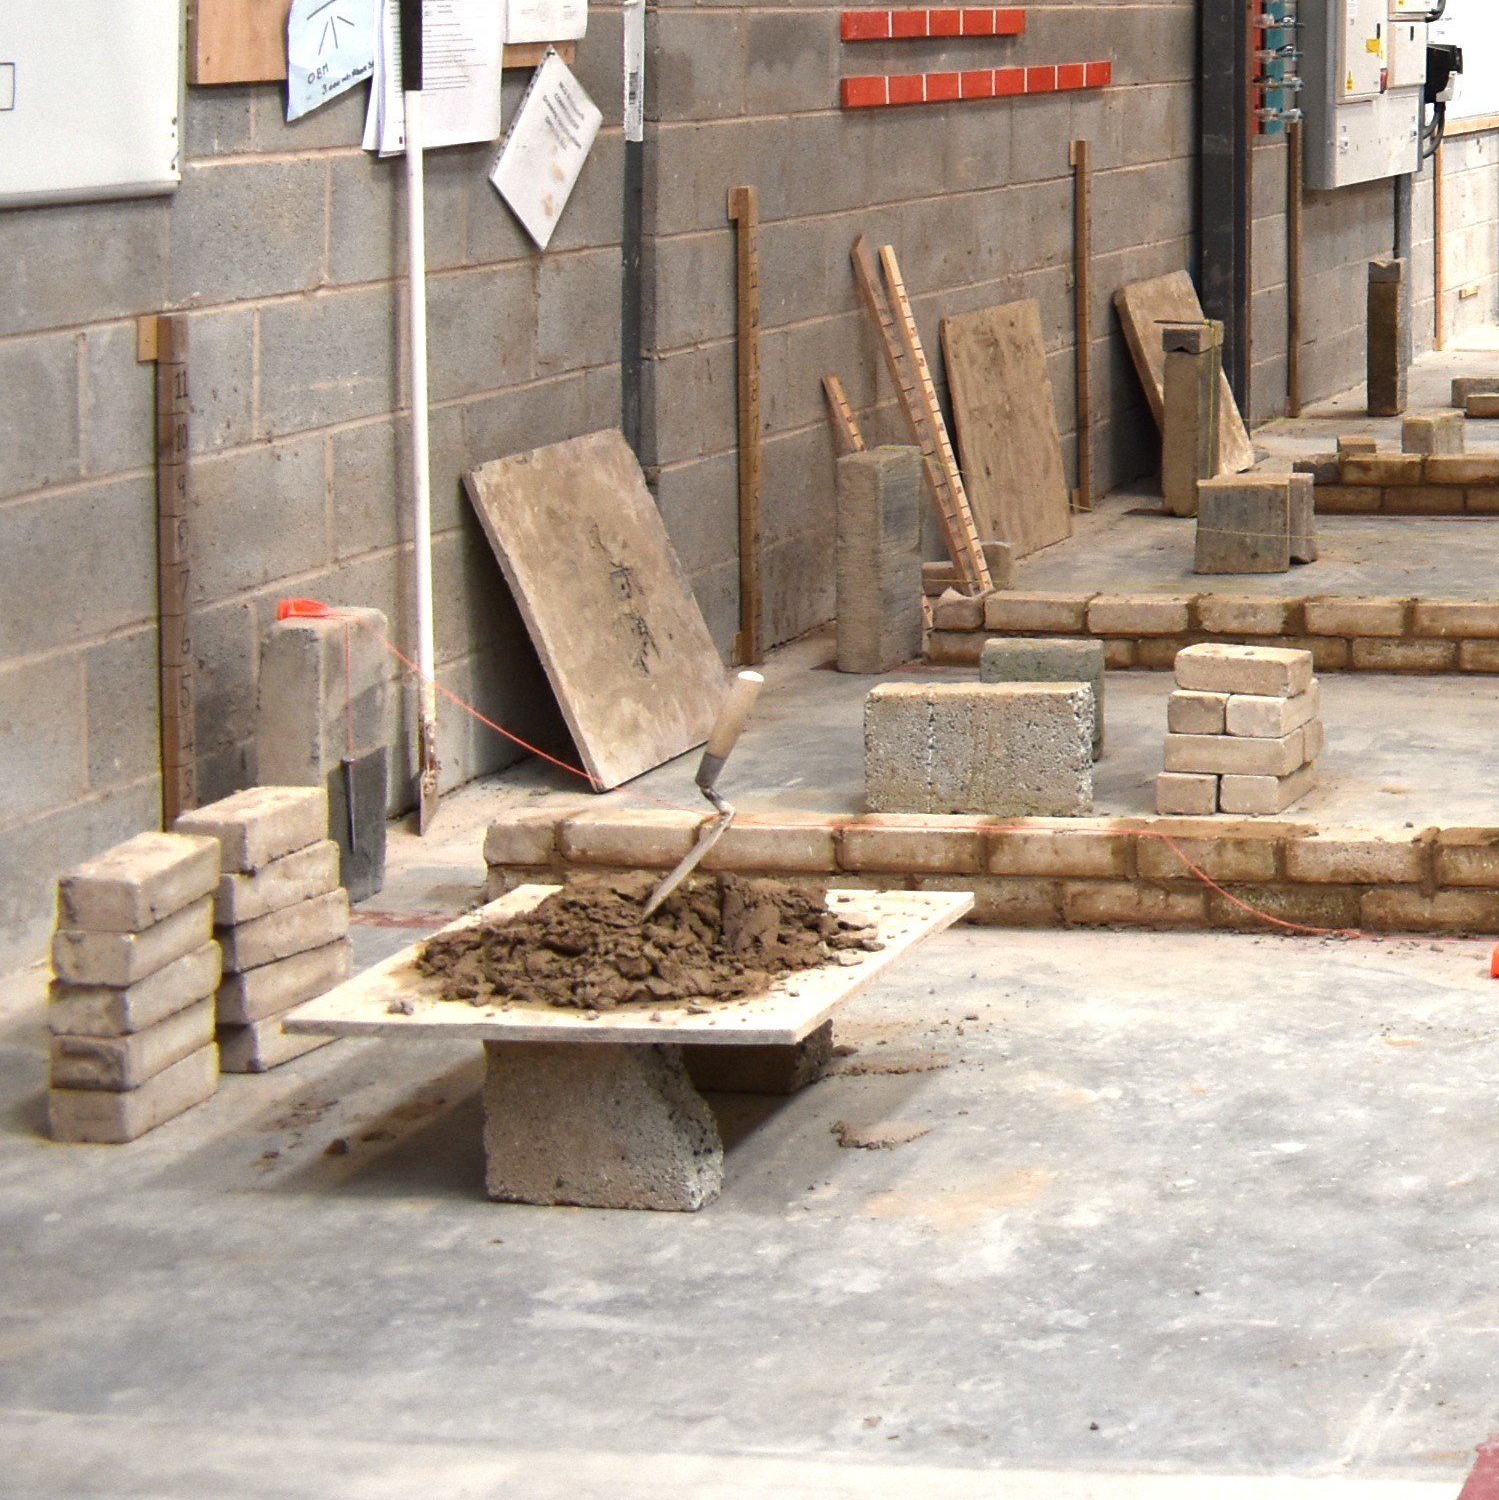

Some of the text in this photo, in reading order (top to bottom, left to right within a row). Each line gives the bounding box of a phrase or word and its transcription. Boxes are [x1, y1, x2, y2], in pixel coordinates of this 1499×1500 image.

[175, 370, 189, 399] 11
[176, 423, 188, 453] 10
[179, 568, 190, 601] 7
[180, 673, 192, 709] 5
